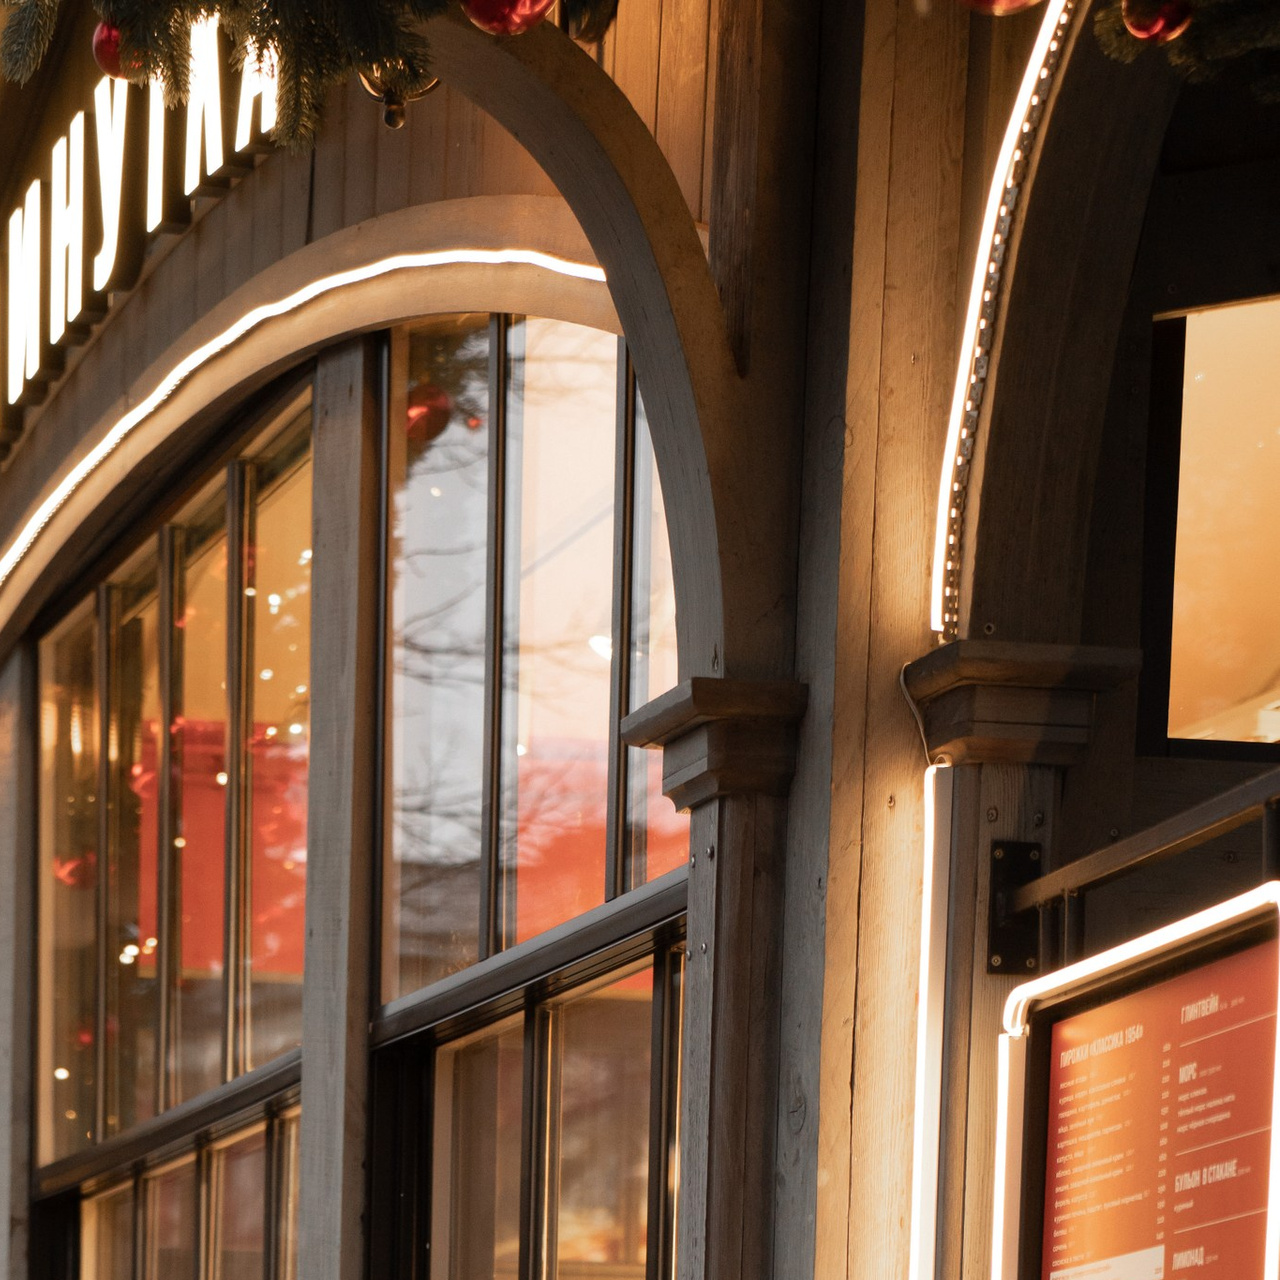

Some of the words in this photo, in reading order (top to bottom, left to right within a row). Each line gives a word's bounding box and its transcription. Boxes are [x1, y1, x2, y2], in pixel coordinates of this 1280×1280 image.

[1181, 994, 1219, 1024] ГЛИНТВЕЙН
[1061, 1043, 1089, 1067] ПИРОЖКИ
[1179, 1063, 1197, 1083] МОРС
[1175, 1170, 1200, 1192] БУЛЬОН
[1202, 1168, 1207, 1185] В
[1208, 1160, 1237, 1183] СТАКАНЕ
[1172, 1247, 1204, 1270] ЛИМОНАД
